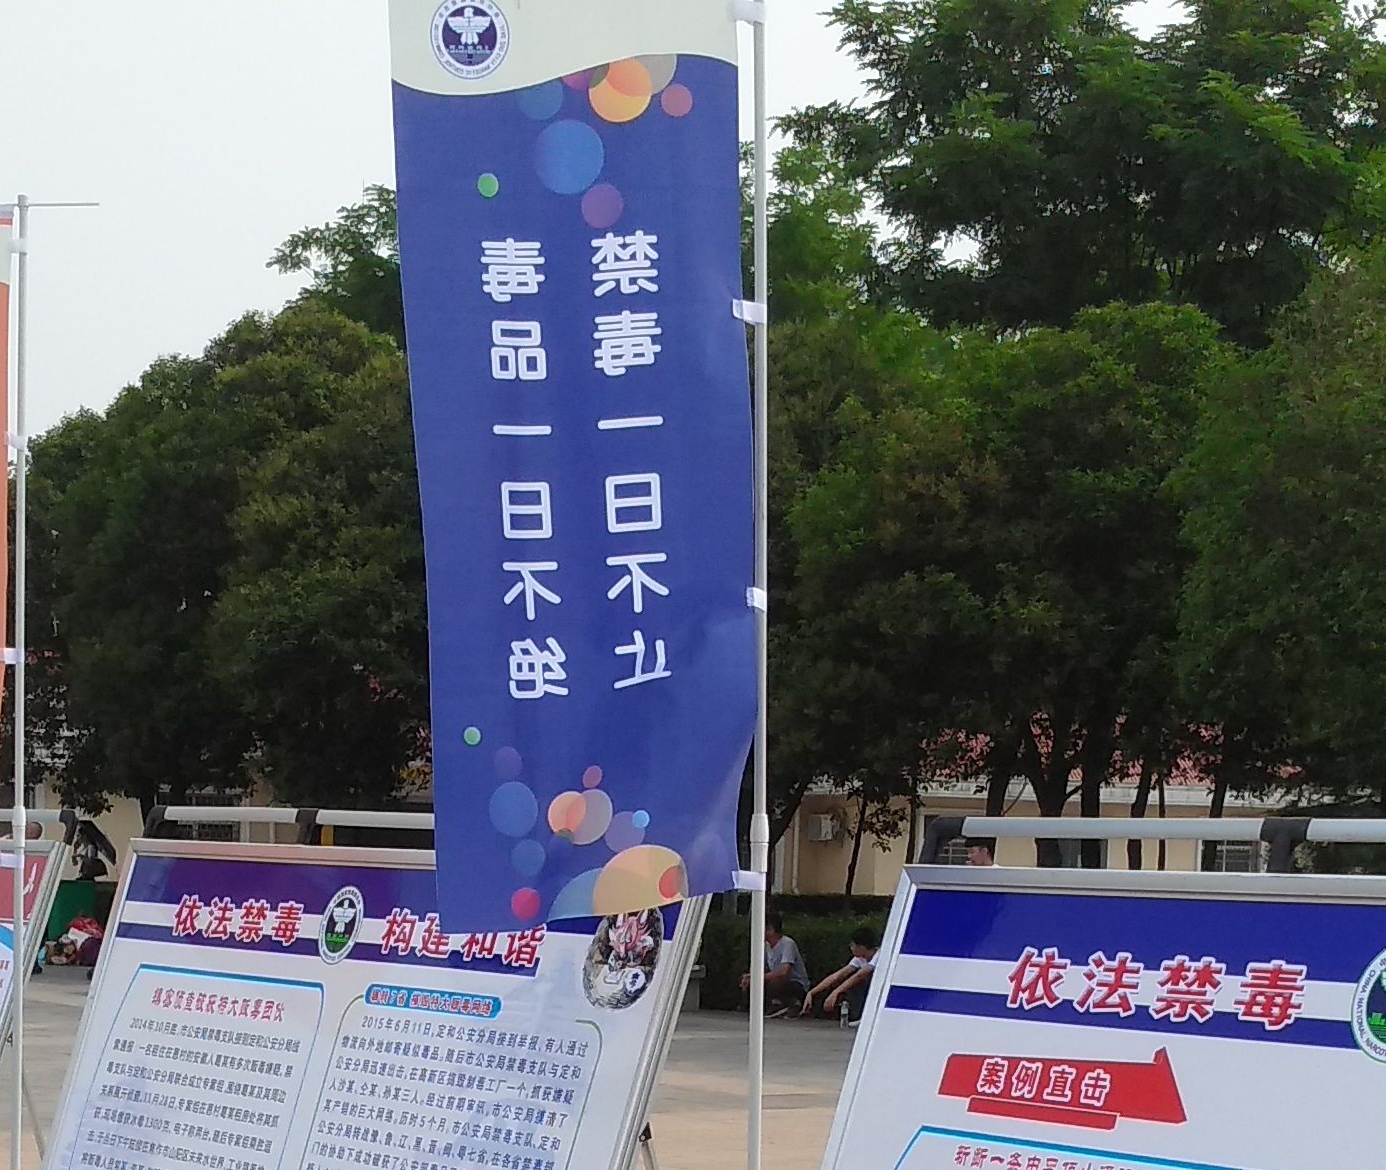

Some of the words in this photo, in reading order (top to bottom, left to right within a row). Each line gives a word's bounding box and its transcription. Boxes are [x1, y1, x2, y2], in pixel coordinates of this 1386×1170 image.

[171, 893, 304, 947] 依法禁毒
[1006, 946, 1308, 1031] 依法禁毒
[1361, 969, 1376, 993] CHINA
[1356, 997, 1367, 1039] NATIONAL
[978, 1058, 1111, 1107] 案例直击
